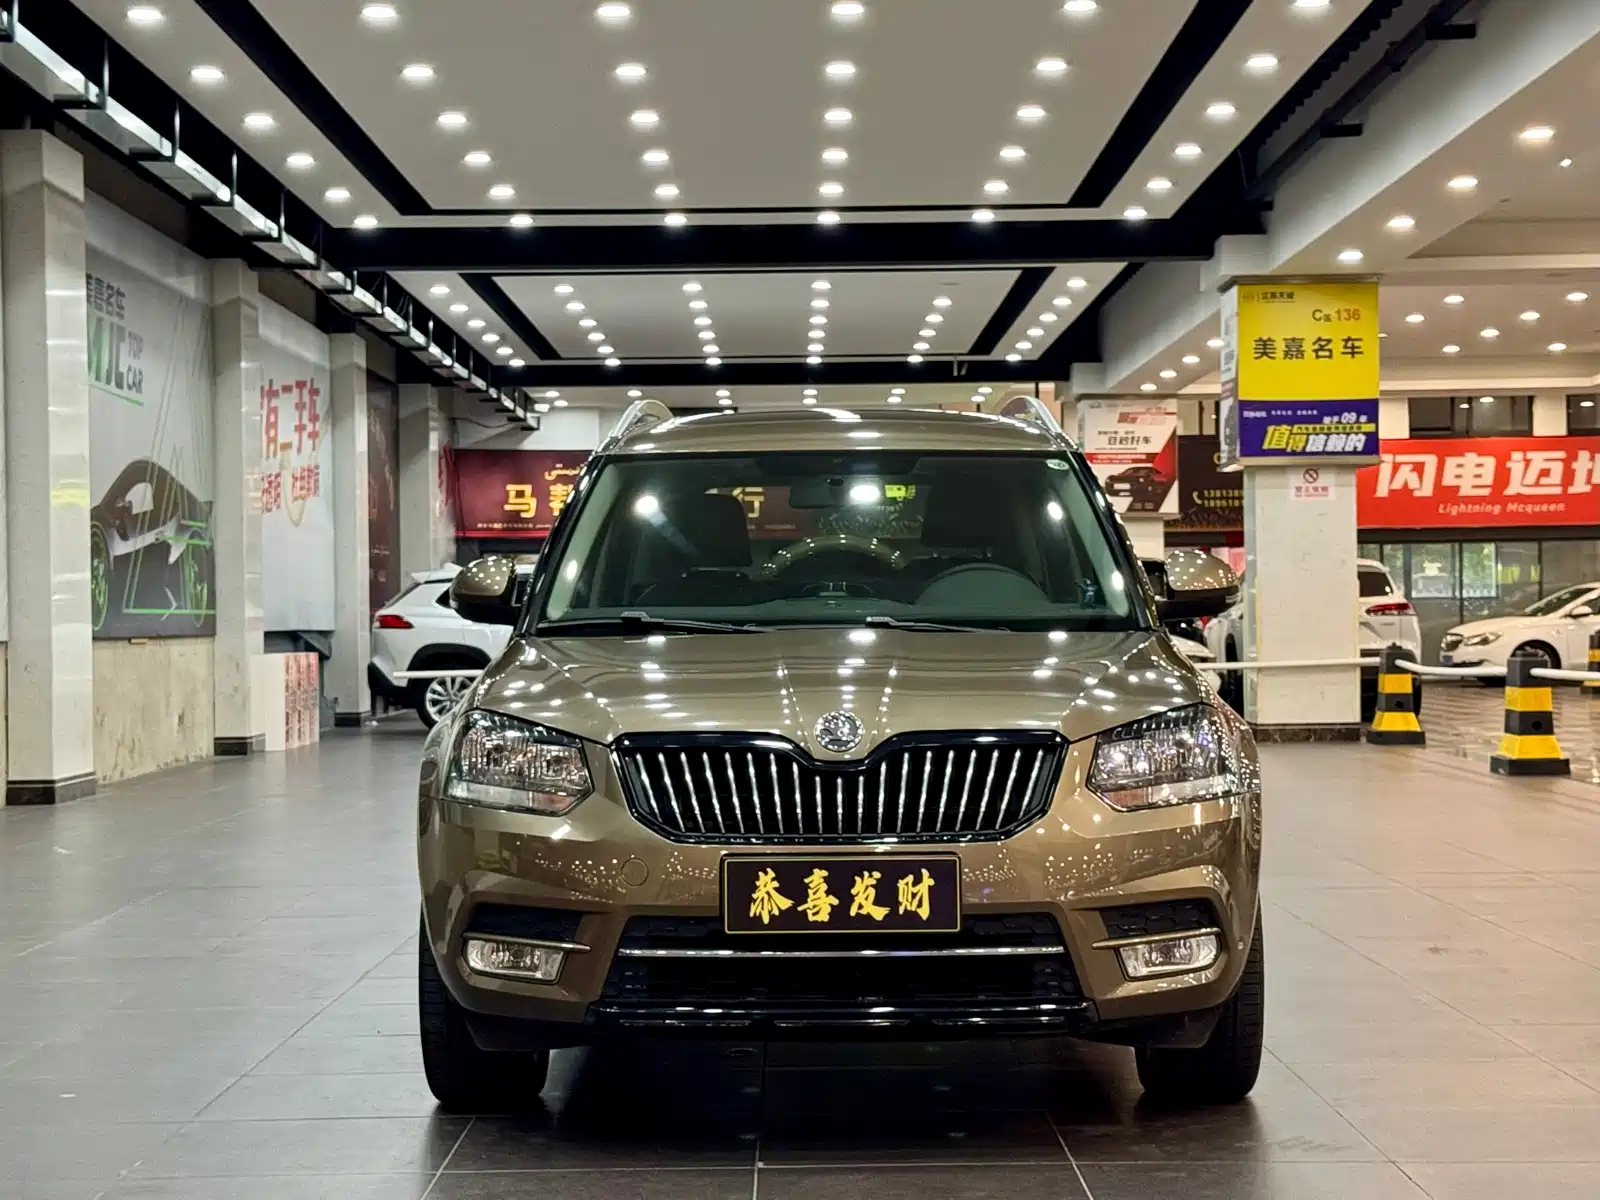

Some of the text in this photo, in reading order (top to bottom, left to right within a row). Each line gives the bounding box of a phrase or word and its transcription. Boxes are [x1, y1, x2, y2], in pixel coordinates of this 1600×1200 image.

[1335, 308, 1361, 321] 136
[128, 331, 144, 359] TOP
[1253, 336, 1364, 360] 美嘉名车
[127, 364, 144, 394] CAR
[1438, 502, 1566, 516] Lightning Mcqueen
[749, 868, 935, 925] 恭喜发财
